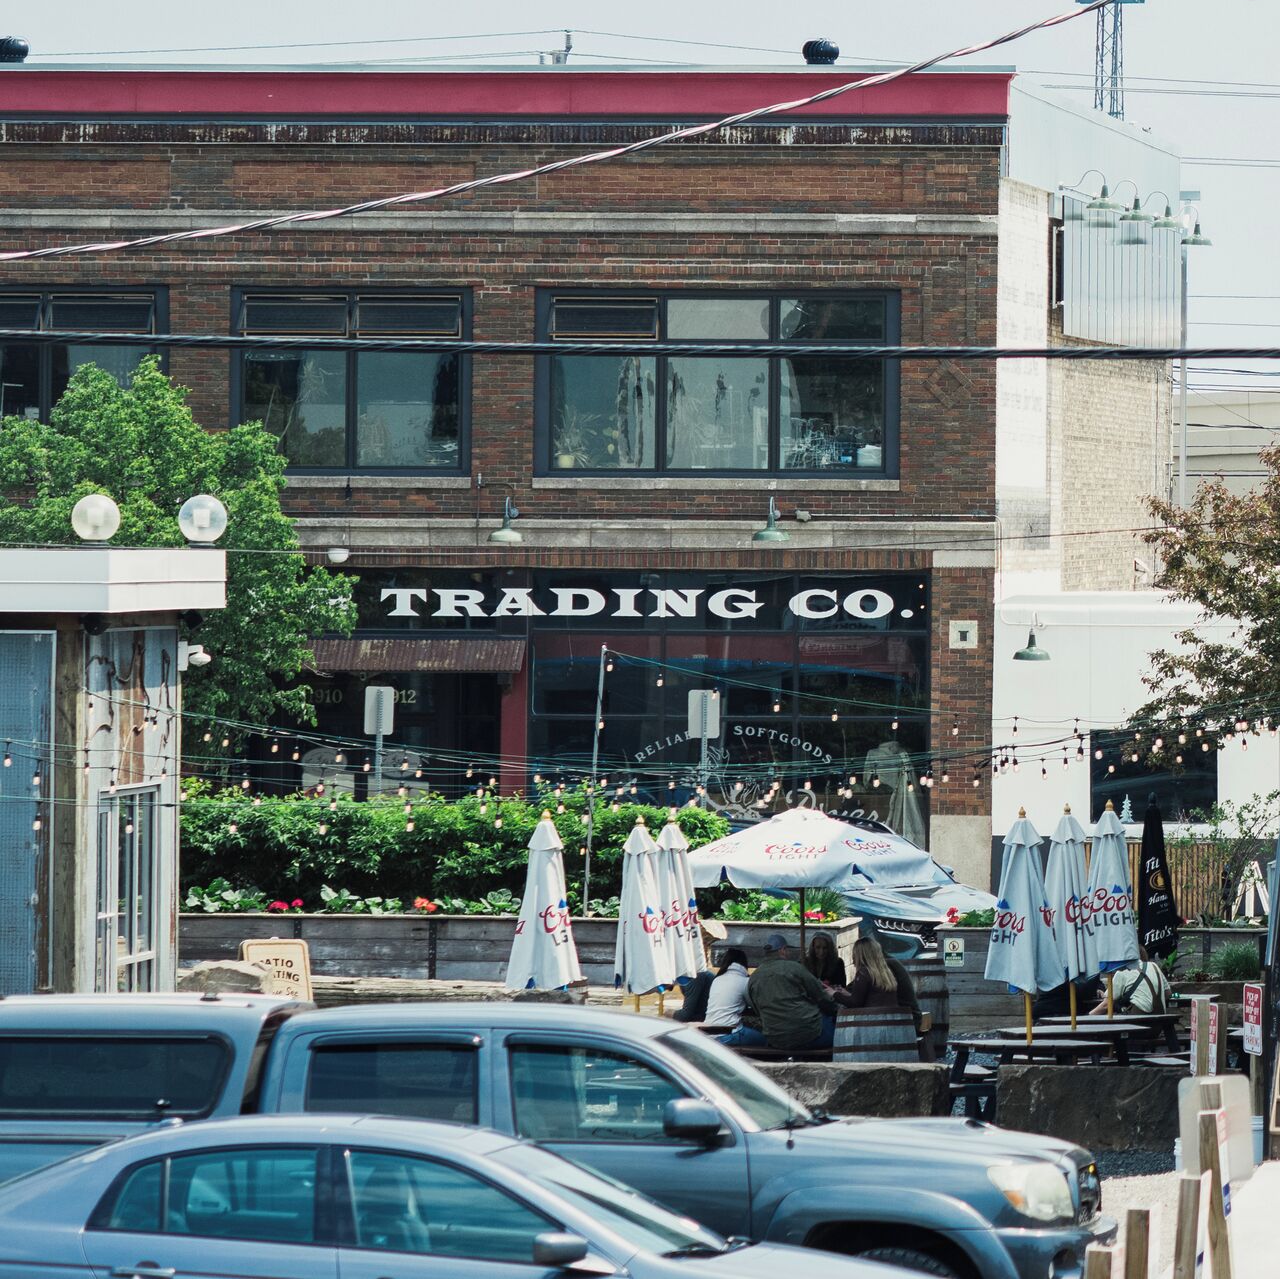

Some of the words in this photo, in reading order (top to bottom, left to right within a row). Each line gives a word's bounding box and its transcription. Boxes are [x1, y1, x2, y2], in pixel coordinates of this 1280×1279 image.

[380, 588, 765, 619] TRADING
[788, 588, 914, 619] CO.
[733, 725, 832, 765] SOFTGOODS
[764, 843, 828, 854] Coors
[1144, 925, 1173, 946] Tito's
[260, 958, 294, 968] ATIO
